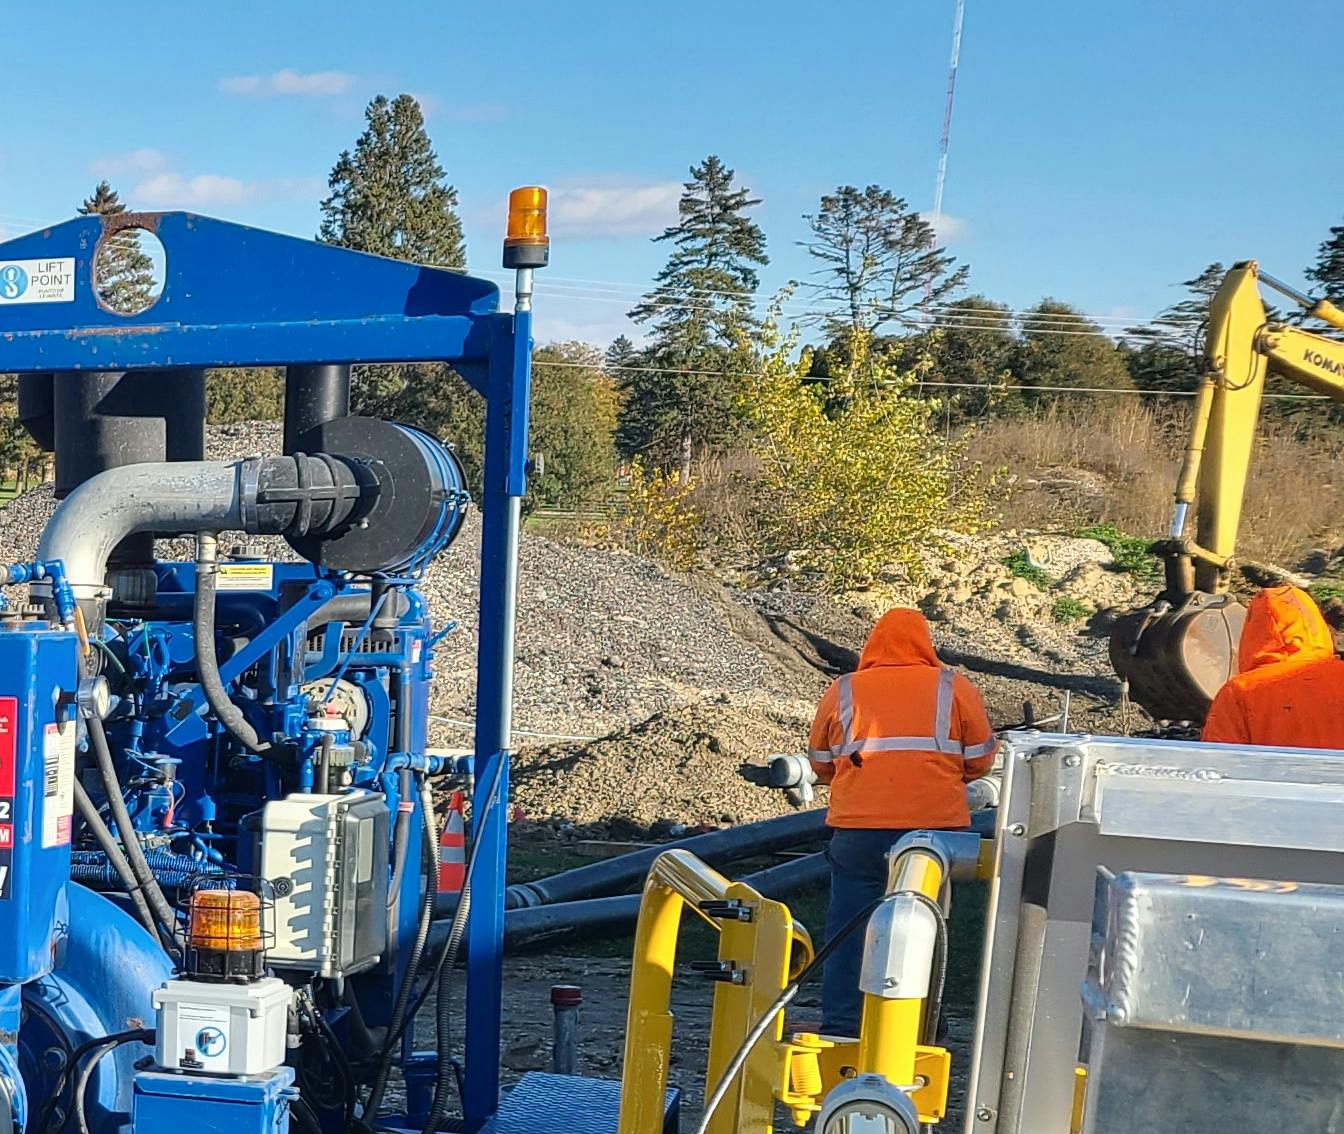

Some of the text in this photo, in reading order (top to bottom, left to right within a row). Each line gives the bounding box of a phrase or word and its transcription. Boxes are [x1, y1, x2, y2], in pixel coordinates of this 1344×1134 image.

[37, 261, 65, 273] LIFT
[31, 274, 71, 287] POINT
[1303, 348, 1344, 378] KOMA
